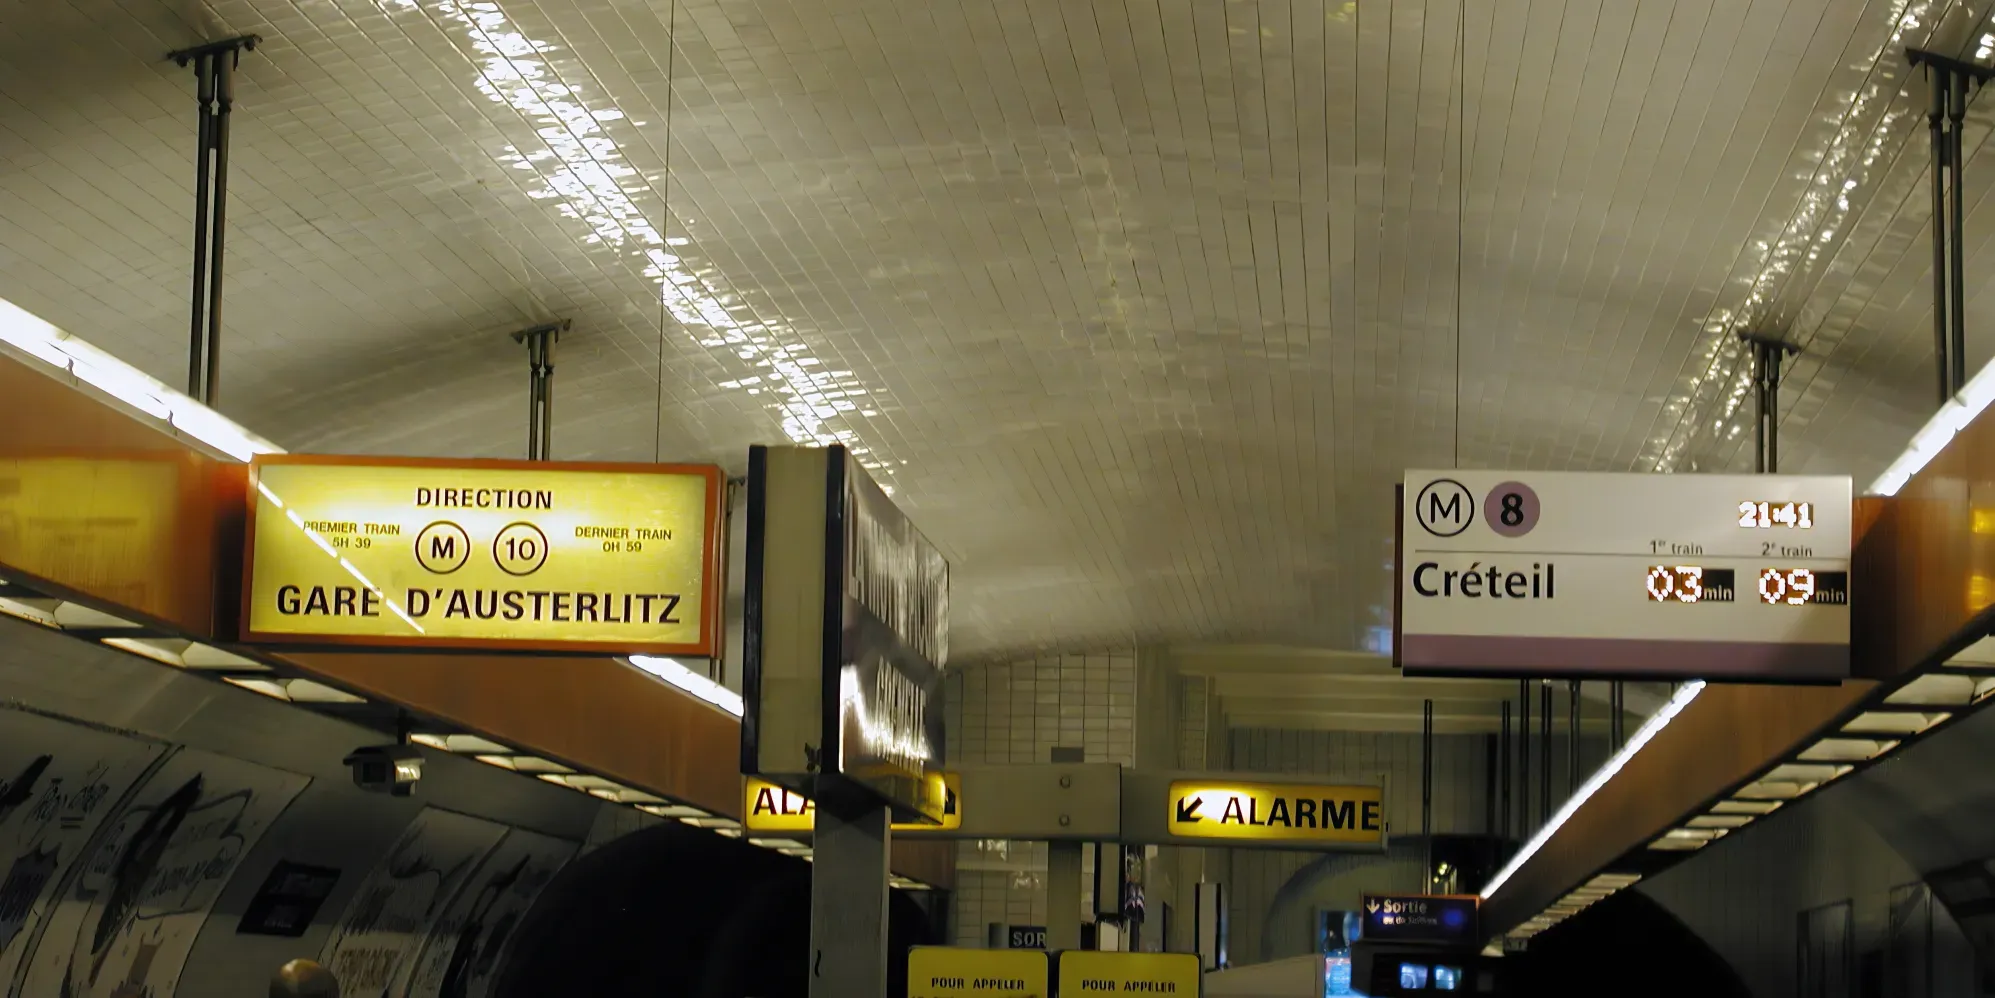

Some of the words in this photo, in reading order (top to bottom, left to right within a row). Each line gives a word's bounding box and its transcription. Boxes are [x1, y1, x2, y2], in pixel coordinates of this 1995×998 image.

[416, 487, 553, 510] DIRECTION
[1429, 492, 1462, 524] M
[1499, 493, 1525, 527] 8
[1739, 501, 1812, 528] 21:41
[303, 521, 357, 534] PREMIER
[364, 523, 400, 535] TRAIN
[575, 526, 629, 539] DERNIER
[635, 528, 672, 540] TRAIN
[332, 537, 349, 548] 5H
[355, 538, 371, 549] 39
[431, 537, 455, 560] M
[505, 538, 535, 561] 10
[625, 542, 642, 552] 59
[1671, 541, 1703, 556] train
[1781, 544, 1813, 558] train
[1413, 561, 1555, 599] Créteil
[1647, 565, 1702, 603] 03
[1704, 585, 1733, 601] min
[1759, 568, 1814, 605] 09
[1816, 587, 1845, 603] min
[276, 585, 382, 618] GARE
[406, 588, 682, 625] D'AUSTERLITZ
[1220, 796, 1381, 831] ALARME
[1383, 899, 1428, 914] Sortie
[931, 977, 965, 989] POUR
[973, 978, 1025, 990] APPELER
[1082, 979, 1116, 992] POUR
[1123, 981, 1176, 994] APPELER
